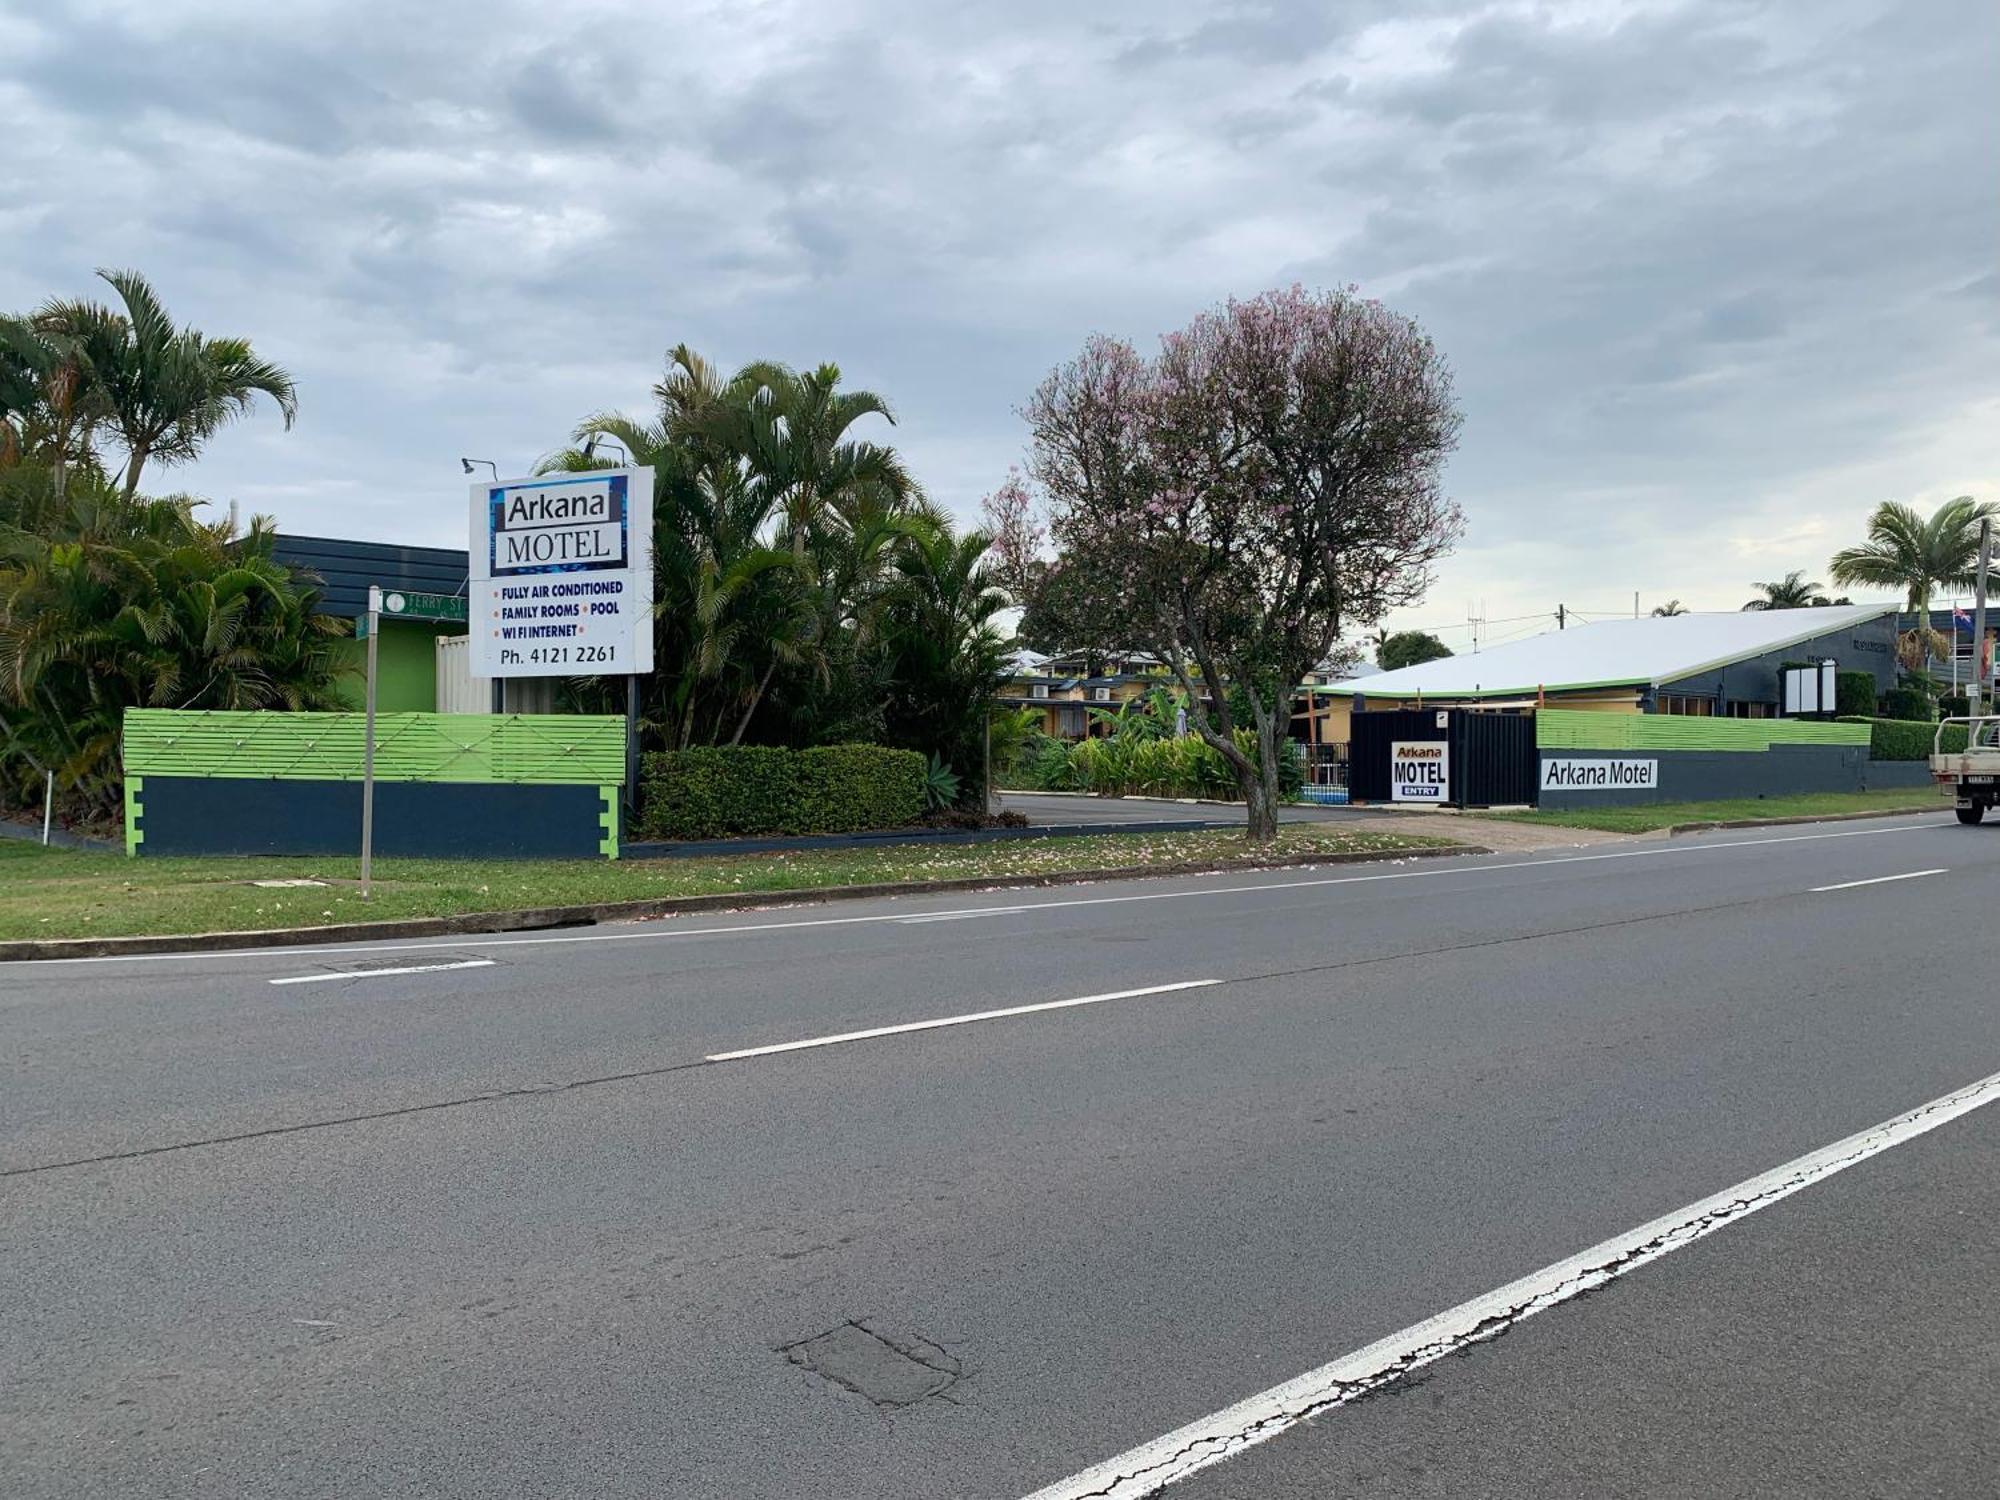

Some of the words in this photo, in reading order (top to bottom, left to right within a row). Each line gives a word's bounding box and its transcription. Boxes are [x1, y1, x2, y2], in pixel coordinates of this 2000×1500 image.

[508, 494, 604, 522] Arkana
[507, 530, 610, 563] MOTEL
[502, 586, 529, 600] FULLY
[532, 585, 549, 598] AIR
[552, 581, 623, 597] CONDITIONED
[409, 595, 442, 609] FERRY
[502, 606, 538, 620] FAMILY
[541, 603, 580, 618] ROOMS
[590, 601, 619, 615] POOL
[502, 627, 516, 639] WI
[518, 626, 527, 639] FI
[529, 624, 577, 638] INTERNET
[501, 650, 524, 664] Ph.
[530, 647, 568, 663] 4121
[576, 645, 615, 662] 2261
[1397, 746, 1442, 758] Arkana
[1395, 762, 1446, 783] MOTEL
[1546, 761, 1606, 785] Arkana
[1609, 761, 1652, 784] Motel
[1404, 787, 1436, 795] ENTRY
